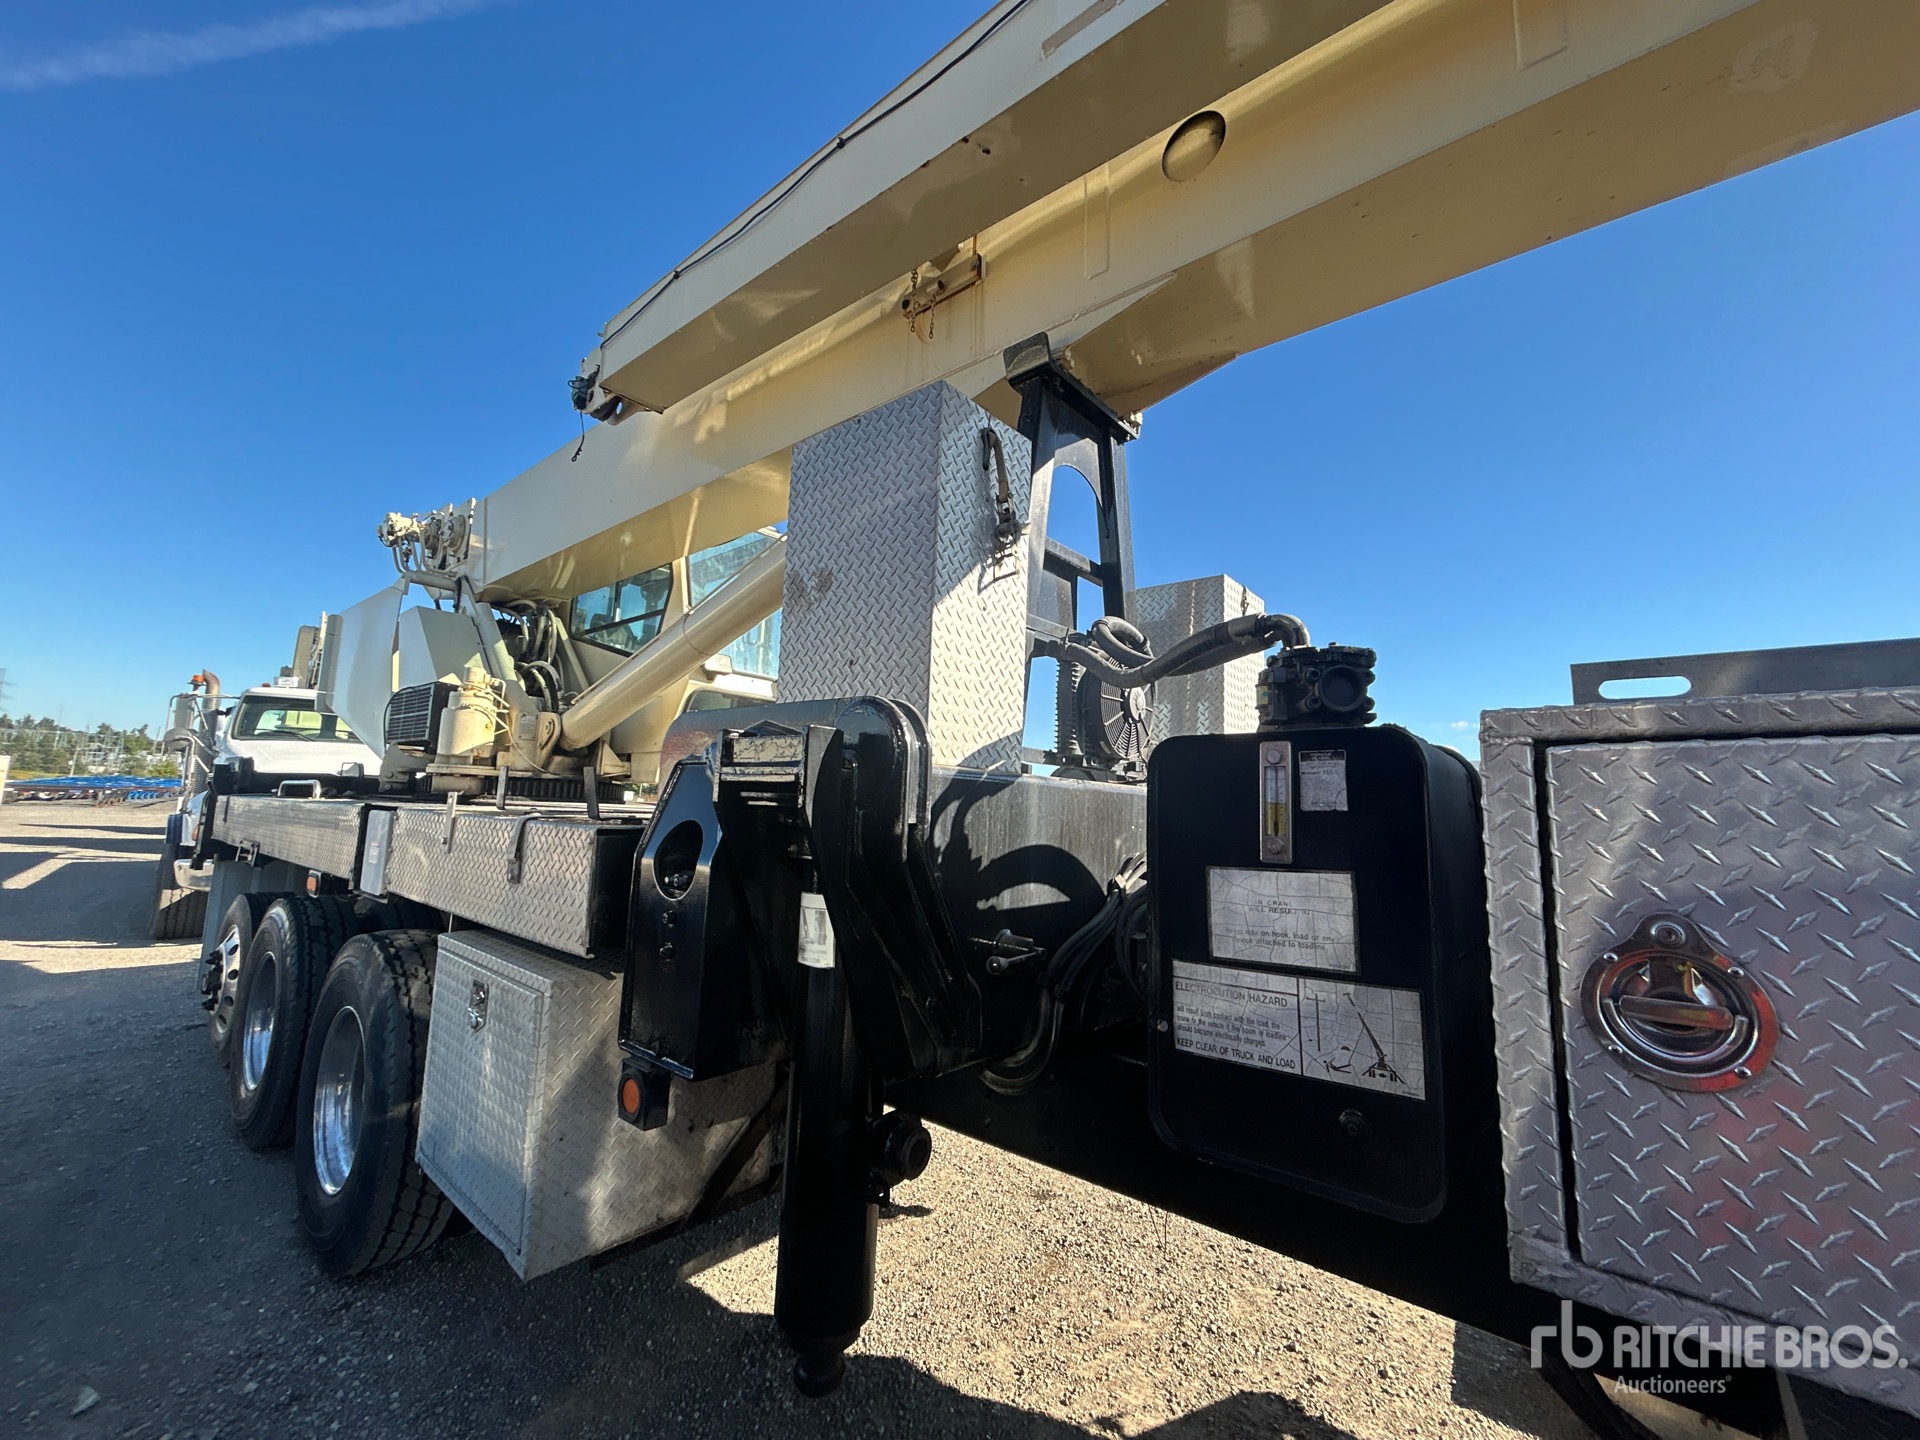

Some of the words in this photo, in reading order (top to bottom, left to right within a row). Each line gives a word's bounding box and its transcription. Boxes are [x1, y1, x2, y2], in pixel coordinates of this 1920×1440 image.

[1256, 938, 1285, 946] attached
[1293, 932, 1308, 940] load
[1176, 981, 1245, 1000] ELECTROCUTION
[1250, 994, 1287, 1007] HAZARD
[1198, 1018, 1206, 1026] the
[1242, 1026, 1256, 1035] boom
[1266, 1030, 1286, 1041] loadline
[1213, 1011, 1232, 1020] contact
[1272, 1020, 1280, 1030] the
[1215, 1029, 1241, 1043] electrically
[1176, 1037, 1193, 1047] KEEP
[1196, 1040, 1217, 1053] CLEAR
[1220, 1046, 1228, 1055] OF
[1231, 1048, 1255, 1061] TRUCK
[1258, 1054, 1273, 1064] AND
[1276, 1058, 1296, 1069] LOAD
